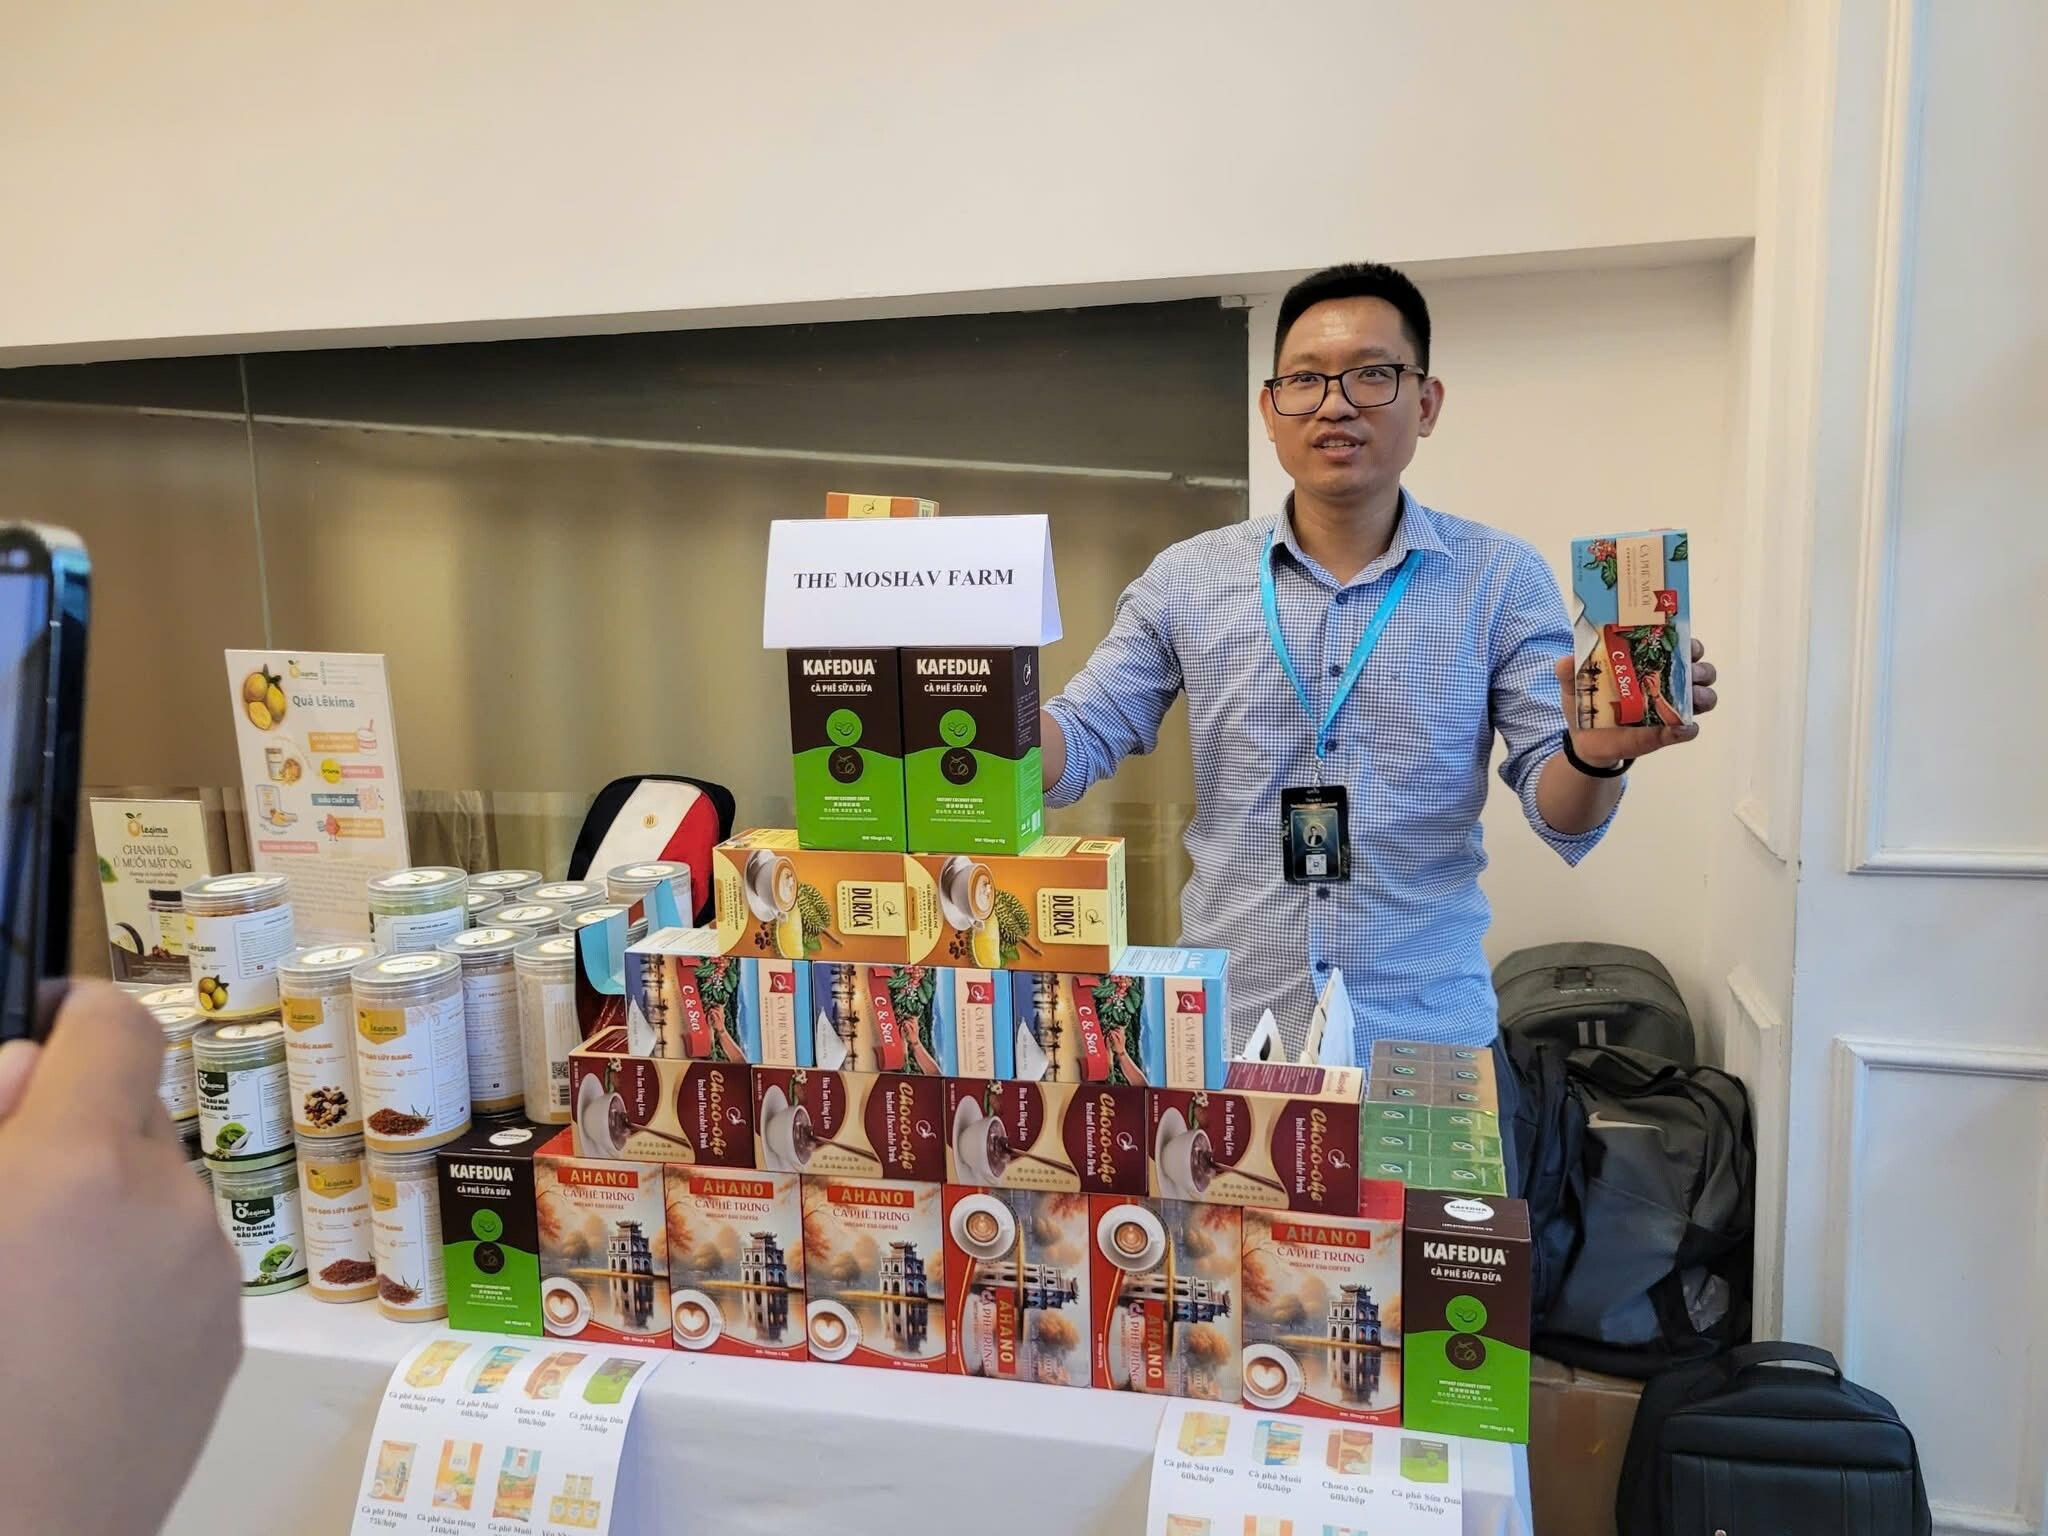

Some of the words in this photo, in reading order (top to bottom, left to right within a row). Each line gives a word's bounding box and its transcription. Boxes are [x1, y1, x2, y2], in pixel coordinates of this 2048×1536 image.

[794, 572, 837, 589] THE
[844, 570, 942, 588] MOSHAV
[949, 569, 1014, 586] FARM
[1611, 651, 1625, 662] C
[803, 659, 875, 676] KAFEDUA
[917, 659, 990, 676] KAFEDUA
[1614, 666, 1626, 675] &
[811, 683, 821, 692] CÀ
[822, 683, 836, 692] PHÊ
[924, 683, 934, 692] CÀ
[936, 683, 950, 692] PHÊ
[1617, 676, 1631, 697] Sea
[292, 694, 314, 708] Quả
[122, 844, 156, 856] CHANH
[169, 858, 192, 870] ONG
[851, 887, 872, 928] DURICA
[1053, 895, 1076, 936] DURICA
[682, 985, 694, 994] C
[684, 998, 696, 1009] &
[874, 996, 887, 1007] C
[876, 1010, 888, 1020] &
[1079, 1006, 1092, 1016] C
[688, 1010, 701, 1032] Sea
[1081, 1019, 1094, 1030] &
[880, 1022, 894, 1043] Sea
[1084, 1032, 1098, 1055] Sea
[698, 1102, 708, 1132] Chocolate
[887, 1115, 896, 1145] Chocolate
[700, 1133, 709, 1149] Drink
[1086, 1126, 1096, 1157] Chocolate
[888, 1146, 897, 1163] Drink
[1296, 1143, 1306, 1174] Chocolate
[450, 1164, 513, 1182] KAFEDUA
[1087, 1159, 1096, 1176] Drink
[570, 1169, 629, 1185] AHANO
[1296, 1176, 1306, 1193] Drink
[457, 1184, 466, 1194] CÀ
[704, 1181, 764, 1196] AHANO
[841, 1188, 905, 1205] AHANO
[1286, 1226, 1358, 1245] AHANO
[1424, 1242, 1506, 1266] KAFEDUA
[1431, 1266, 1442, 1276] CÀ
[1444, 1268, 1460, 1278] PHÊ
[1000, 1300, 1013, 1362] AHANO
[1148, 1315, 1162, 1378] AHANO
[1212, 1465, 1234, 1476] riêng
[1322, 1481, 1349, 1491] Choco
[1357, 1486, 1374, 1494] Oke
